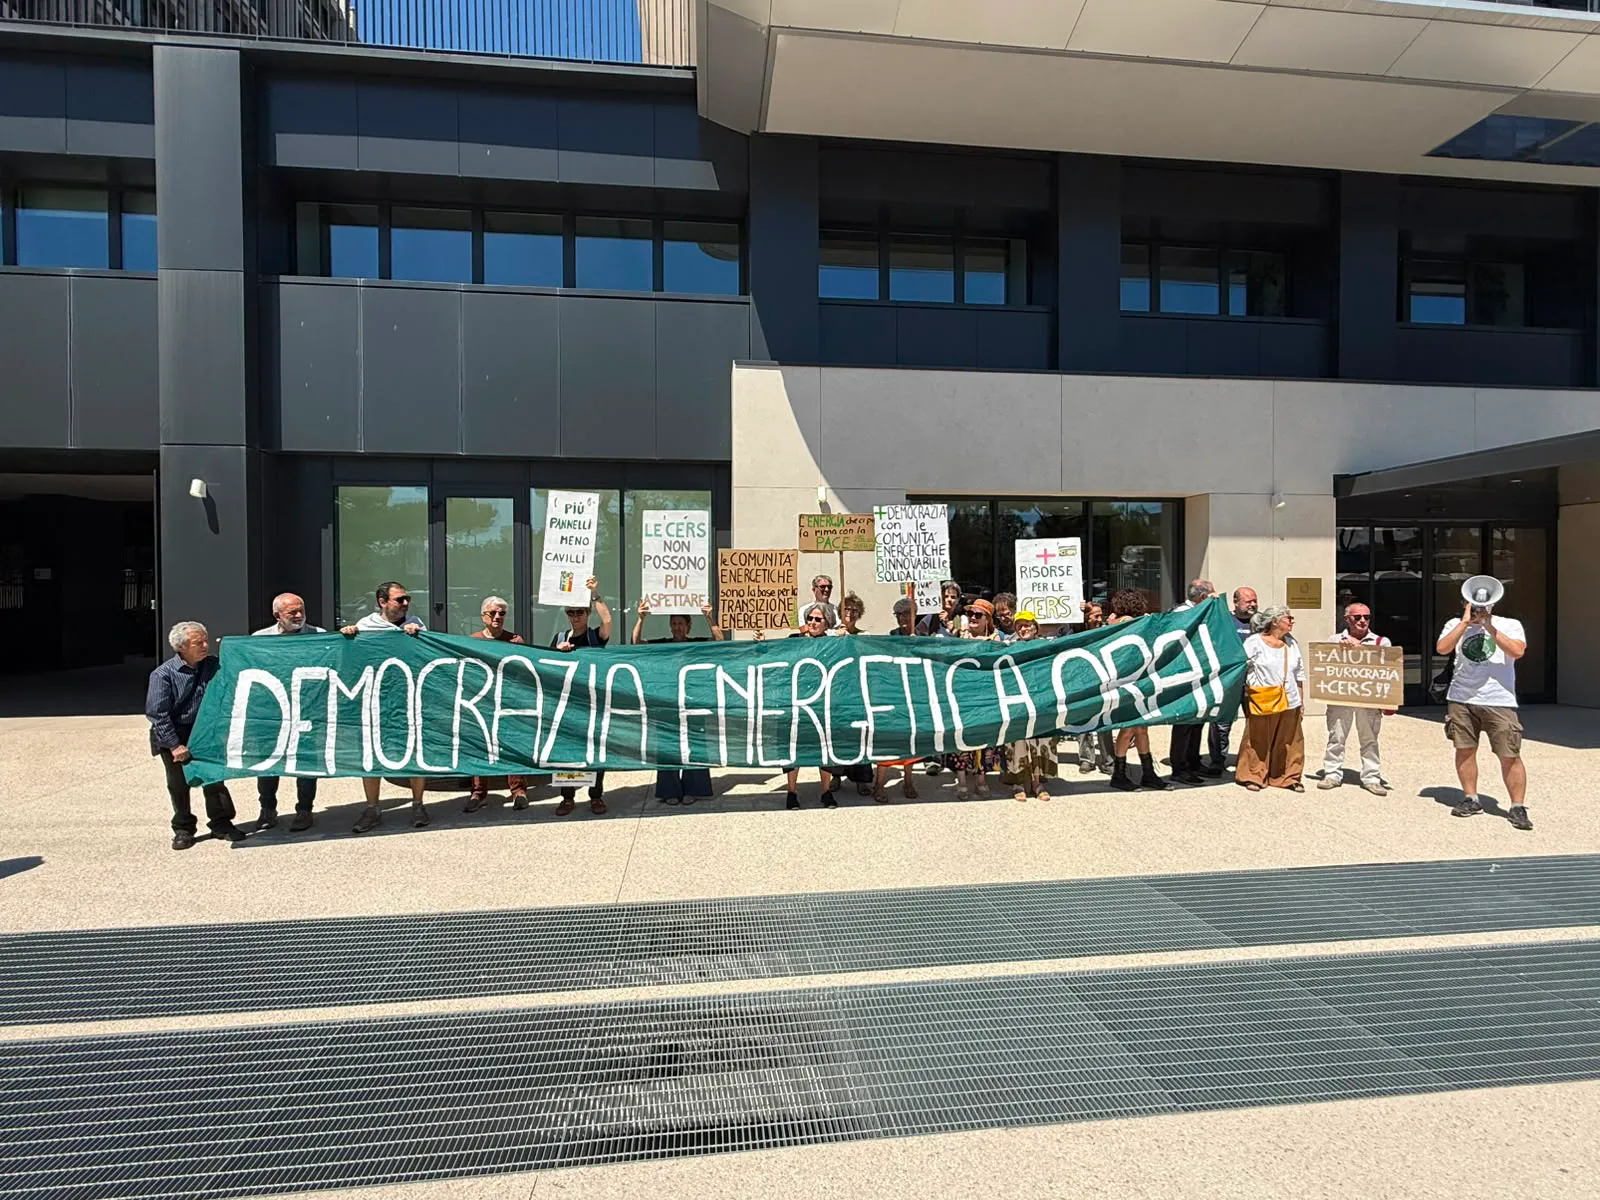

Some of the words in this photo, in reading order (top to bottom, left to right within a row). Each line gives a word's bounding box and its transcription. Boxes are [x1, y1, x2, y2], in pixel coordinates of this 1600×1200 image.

[549, 517, 592, 530] PANNELLI
[645, 523, 662, 537] LE
[665, 522, 707, 538] CERS
[881, 521, 901, 530] con
[915, 519, 926, 531] le
[815, 529, 837, 537] rima
[857, 526, 866, 534] la
[560, 535, 590, 546] MENO
[663, 539, 690, 552] NON
[816, 536, 850, 550] PACE
[544, 551, 586, 564] CAVILLI
[876, 543, 946, 558] ENERGETICHE
[643, 554, 706, 570] POSSONO
[876, 556, 941, 572] RINNOVABILI
[877, 569, 922, 582] SOLIDALI
[1020, 565, 1073, 579] RISORSE
[720, 588, 745, 598] sono
[747, 584, 756, 597] la
[757, 585, 776, 597] base
[777, 588, 790, 599] per
[1031, 582, 1049, 592] PER
[1051, 582, 1064, 592] LE
[643, 593, 706, 608] ASPETTARE
[720, 597, 794, 613] TRANSIZIONE
[918, 597, 941, 607] ERS!
[1021, 596, 1071, 619] CERS
[721, 612, 791, 629] ENERGETICA
[226, 654, 647, 776] DEMOCRAZIA
[677, 654, 1037, 767] ENERGETICA
[1051, 623, 1226, 733] ORA!
